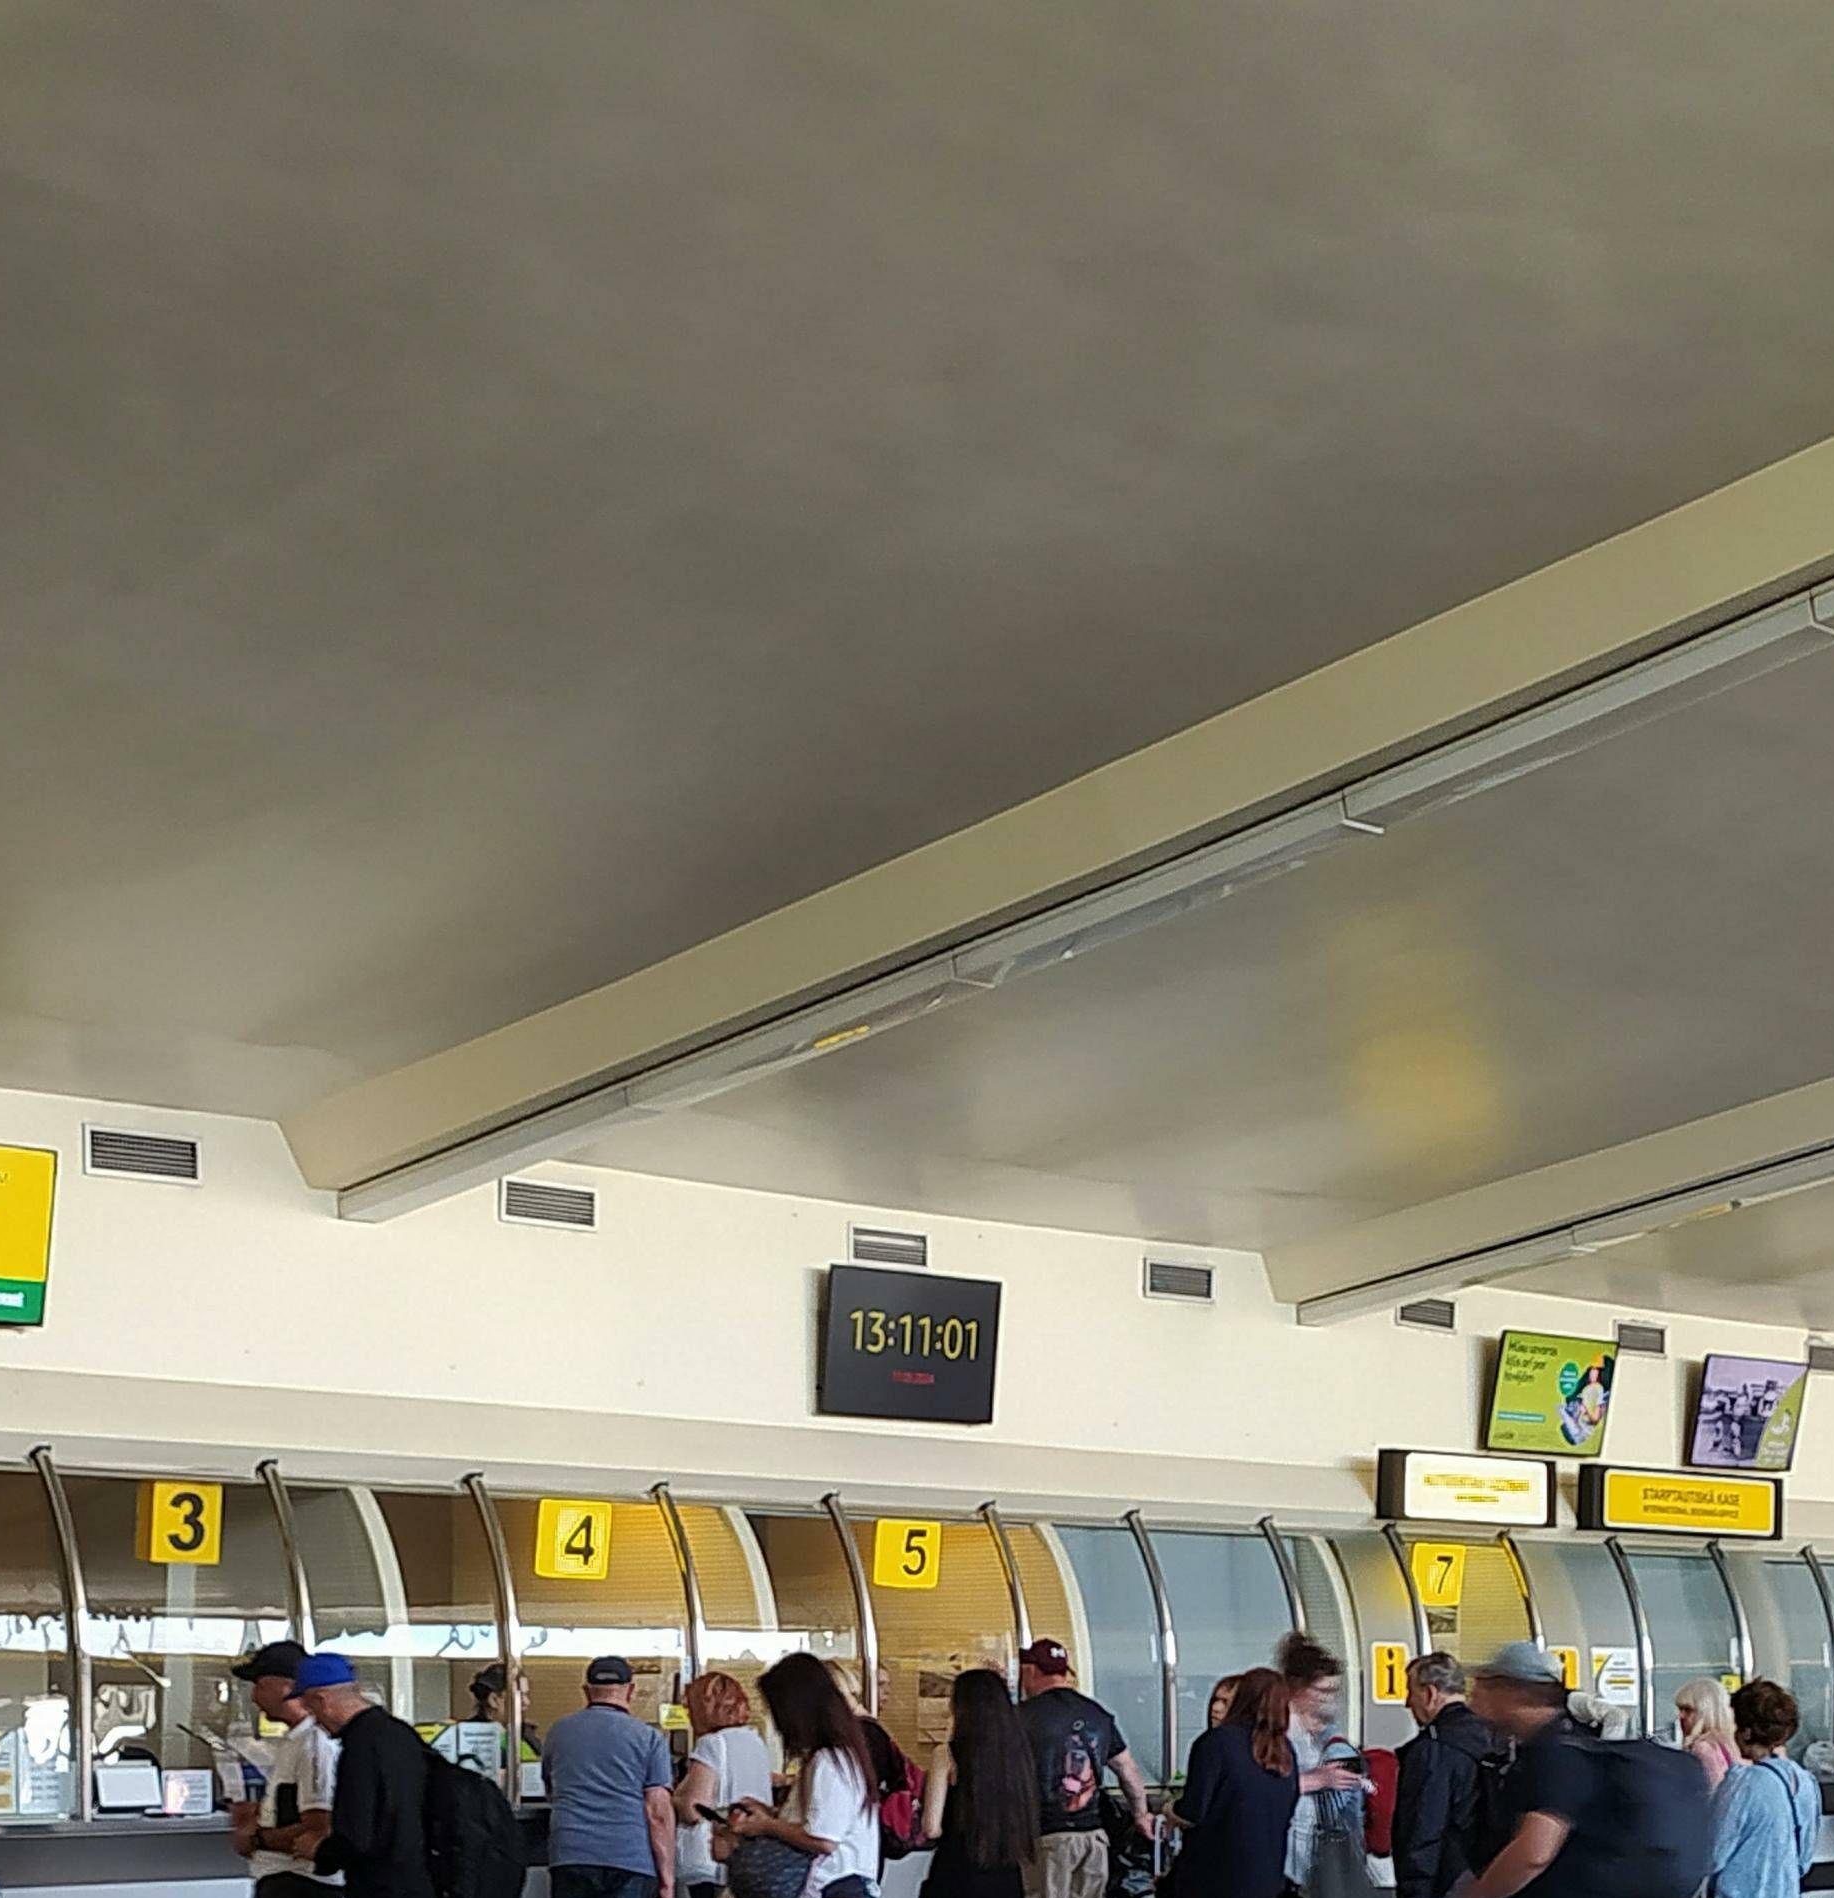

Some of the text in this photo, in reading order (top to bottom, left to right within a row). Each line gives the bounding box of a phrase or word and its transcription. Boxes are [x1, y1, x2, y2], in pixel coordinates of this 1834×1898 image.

[849, 1309, 979, 1361] 13:11:01
[167, 1491, 205, 1552] 3
[564, 1514, 596, 1566] 4
[901, 1528, 928, 1576] 5
[1436, 1555, 1454, 1595] 7
